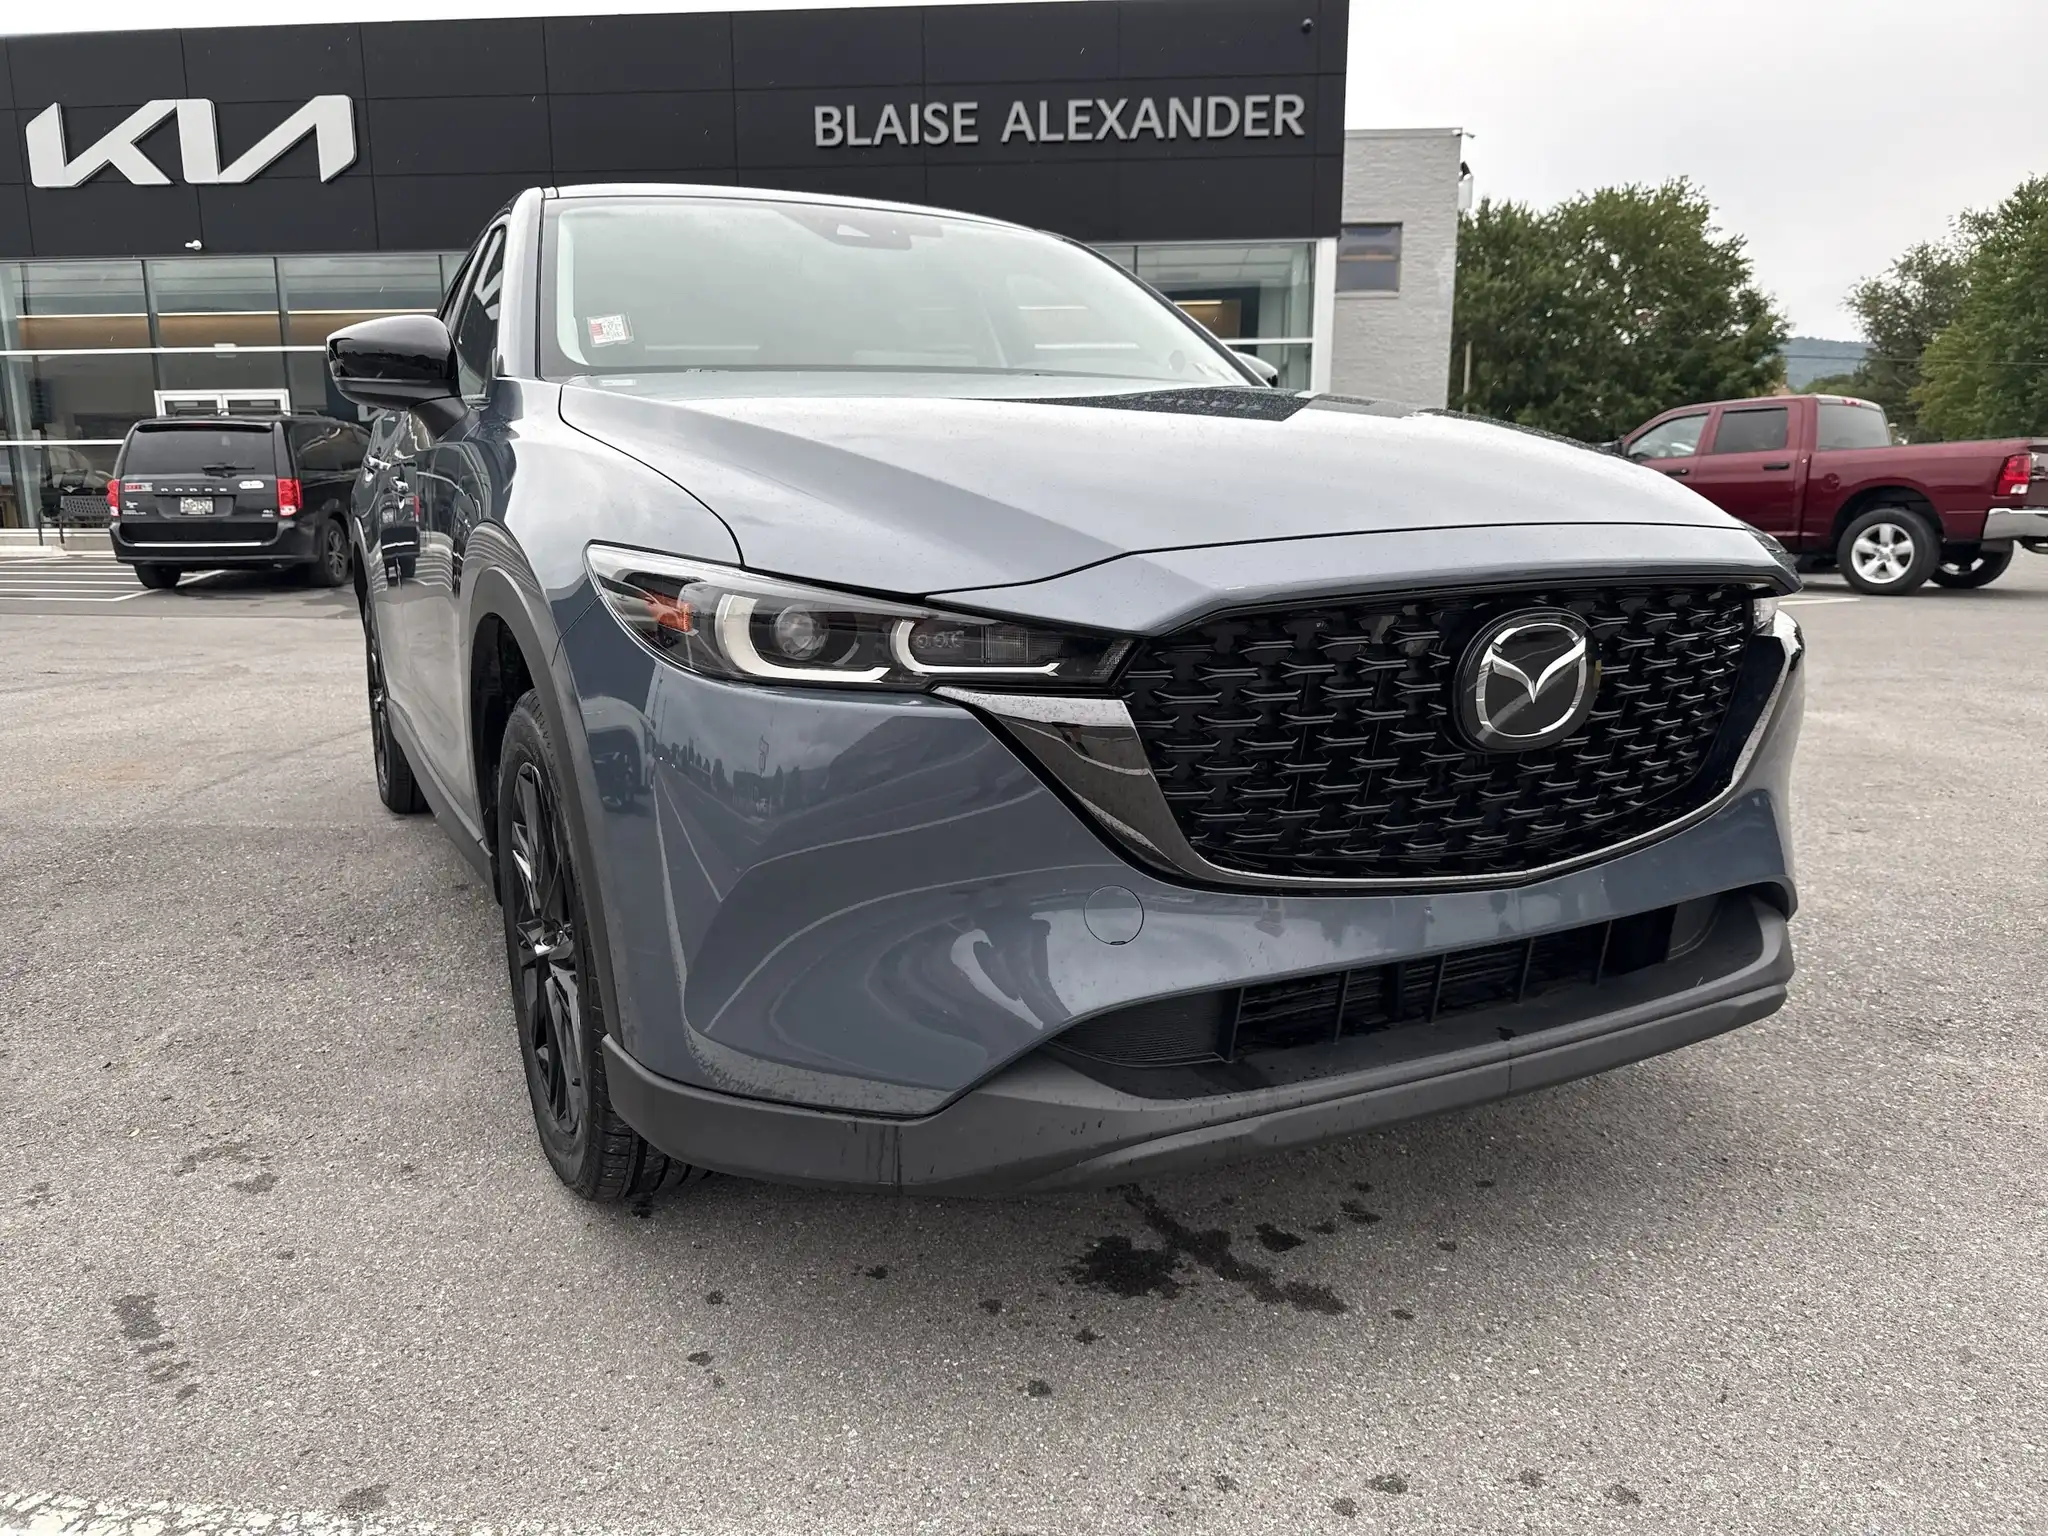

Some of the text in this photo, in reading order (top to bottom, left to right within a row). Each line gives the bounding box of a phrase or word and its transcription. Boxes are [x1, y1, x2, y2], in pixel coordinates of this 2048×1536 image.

[25, 94, 357, 188] KIA
[813, 94, 1305, 147] BLAISE ALEXANDER
